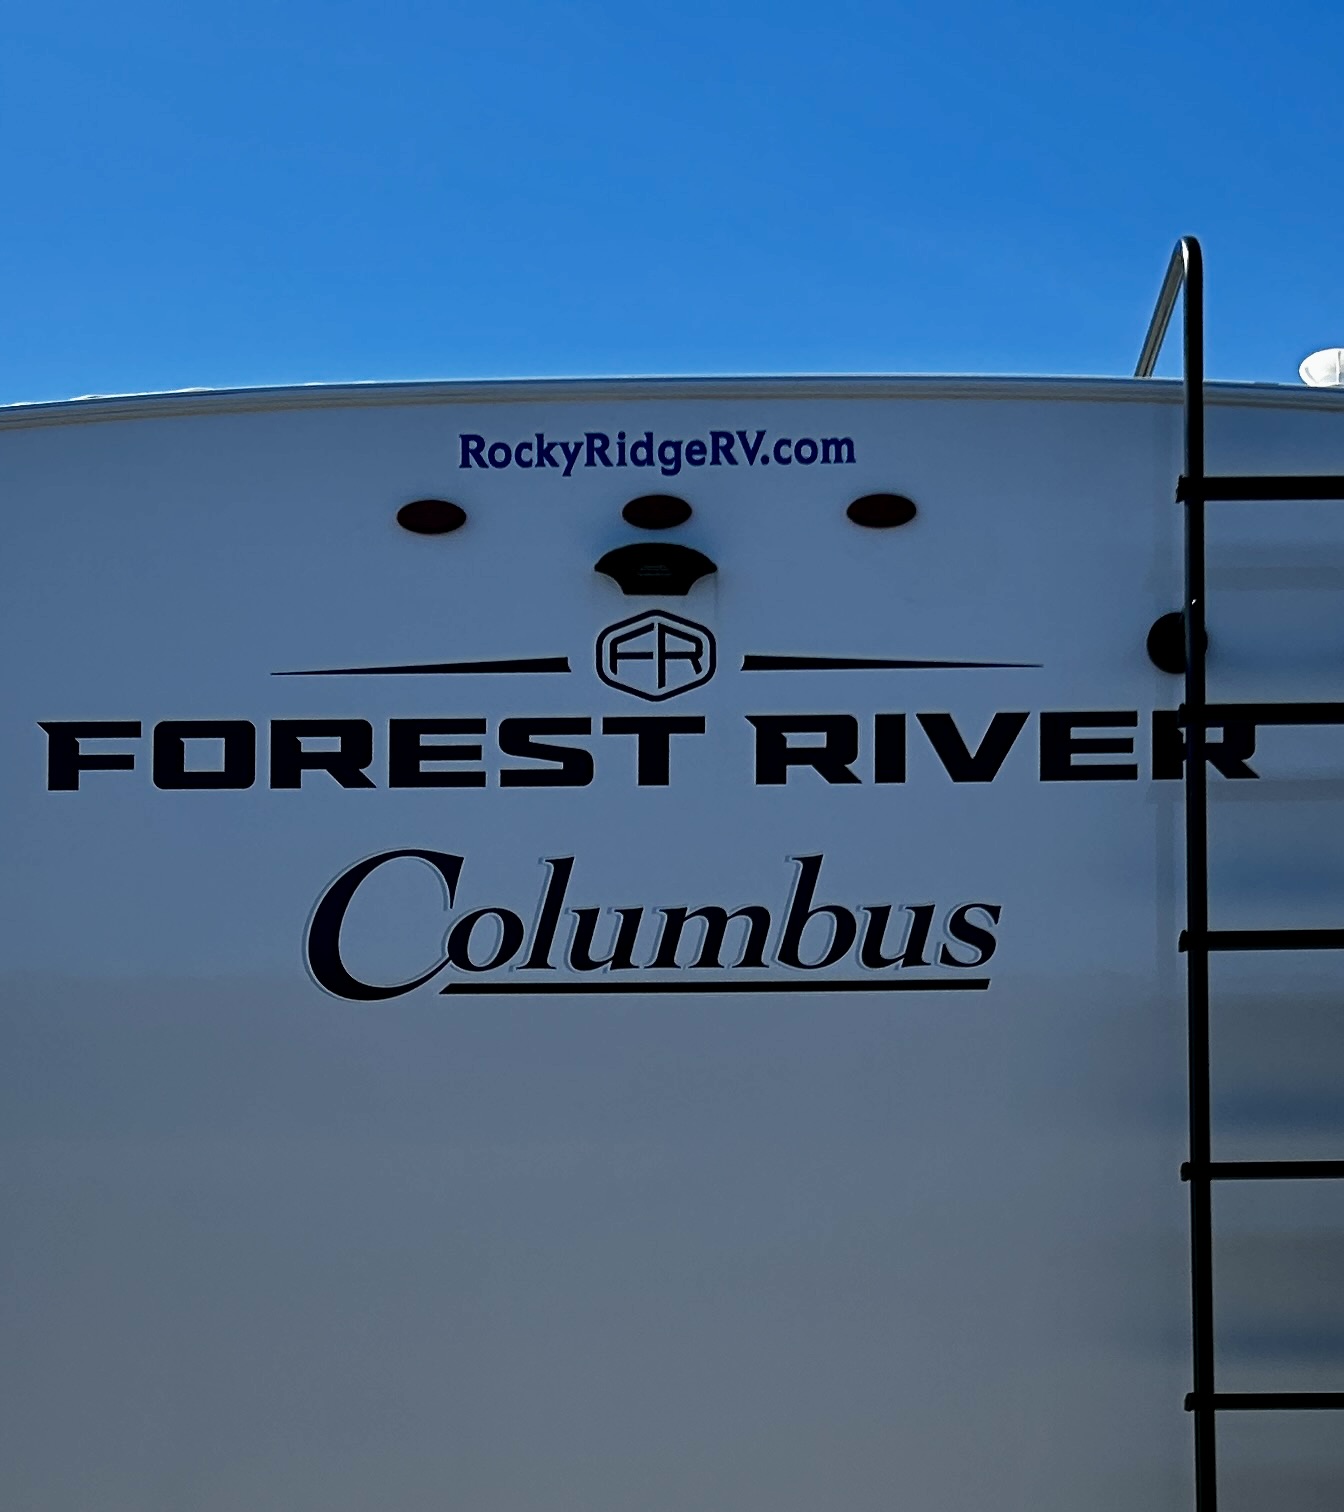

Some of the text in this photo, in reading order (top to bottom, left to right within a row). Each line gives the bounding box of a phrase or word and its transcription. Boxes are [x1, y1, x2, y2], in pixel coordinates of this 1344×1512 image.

[458, 430, 856, 477] RockyRidgeRV.com
[38, 709, 1260, 792] FOREST RIVER
[304, 847, 1002, 1001] Columbus
